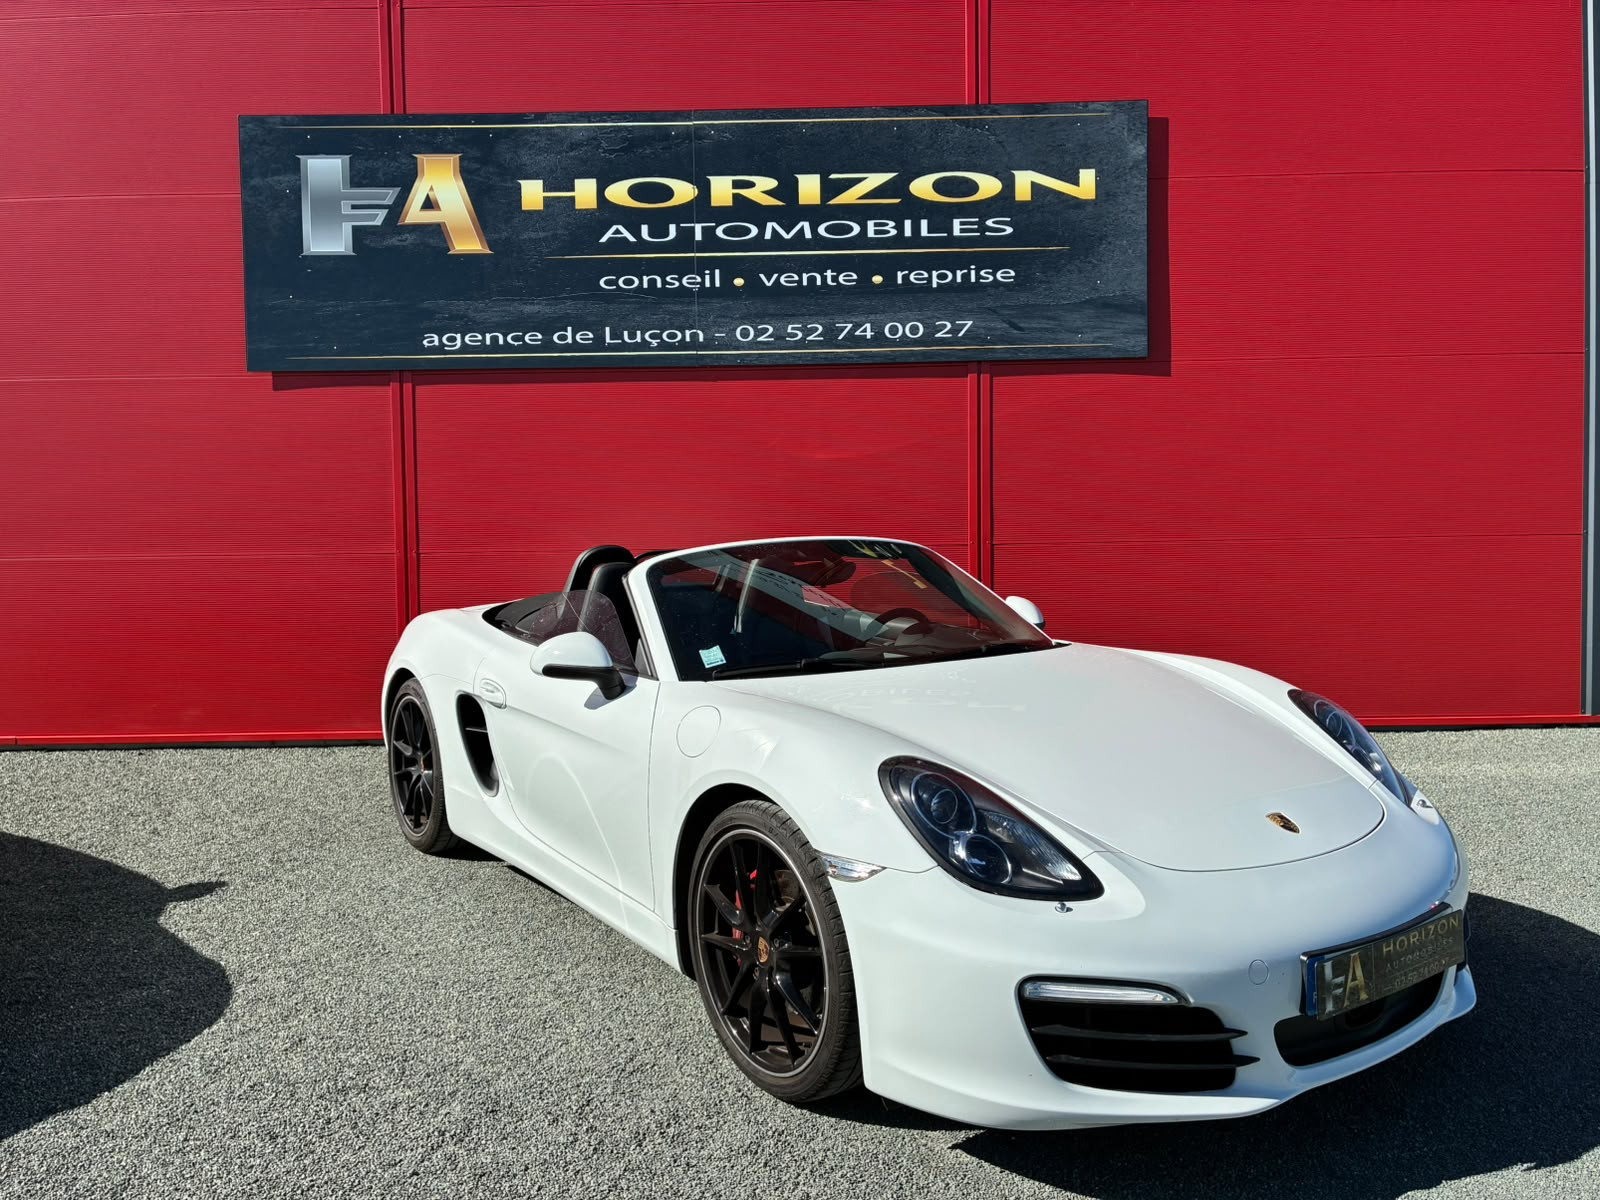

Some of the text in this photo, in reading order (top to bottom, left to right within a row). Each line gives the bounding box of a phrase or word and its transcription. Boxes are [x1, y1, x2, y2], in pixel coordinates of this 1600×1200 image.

[517, 168, 1096, 211] HORIZON
[598, 216, 1014, 243] AUTOMOBILES
[599, 266, 1016, 290] conseil vente reprise
[422, 331, 543, 350] agence
[552, 326, 594, 344] de
[605, 326, 704, 346] Luçon
[735, 325, 775, 342] 02
[785, 324, 824, 341] 52
[835, 323, 875, 340] 74
[884, 321, 924, 339] 00
[934, 320, 974, 338] 27
[1382, 913, 1460, 956] HORIZON
